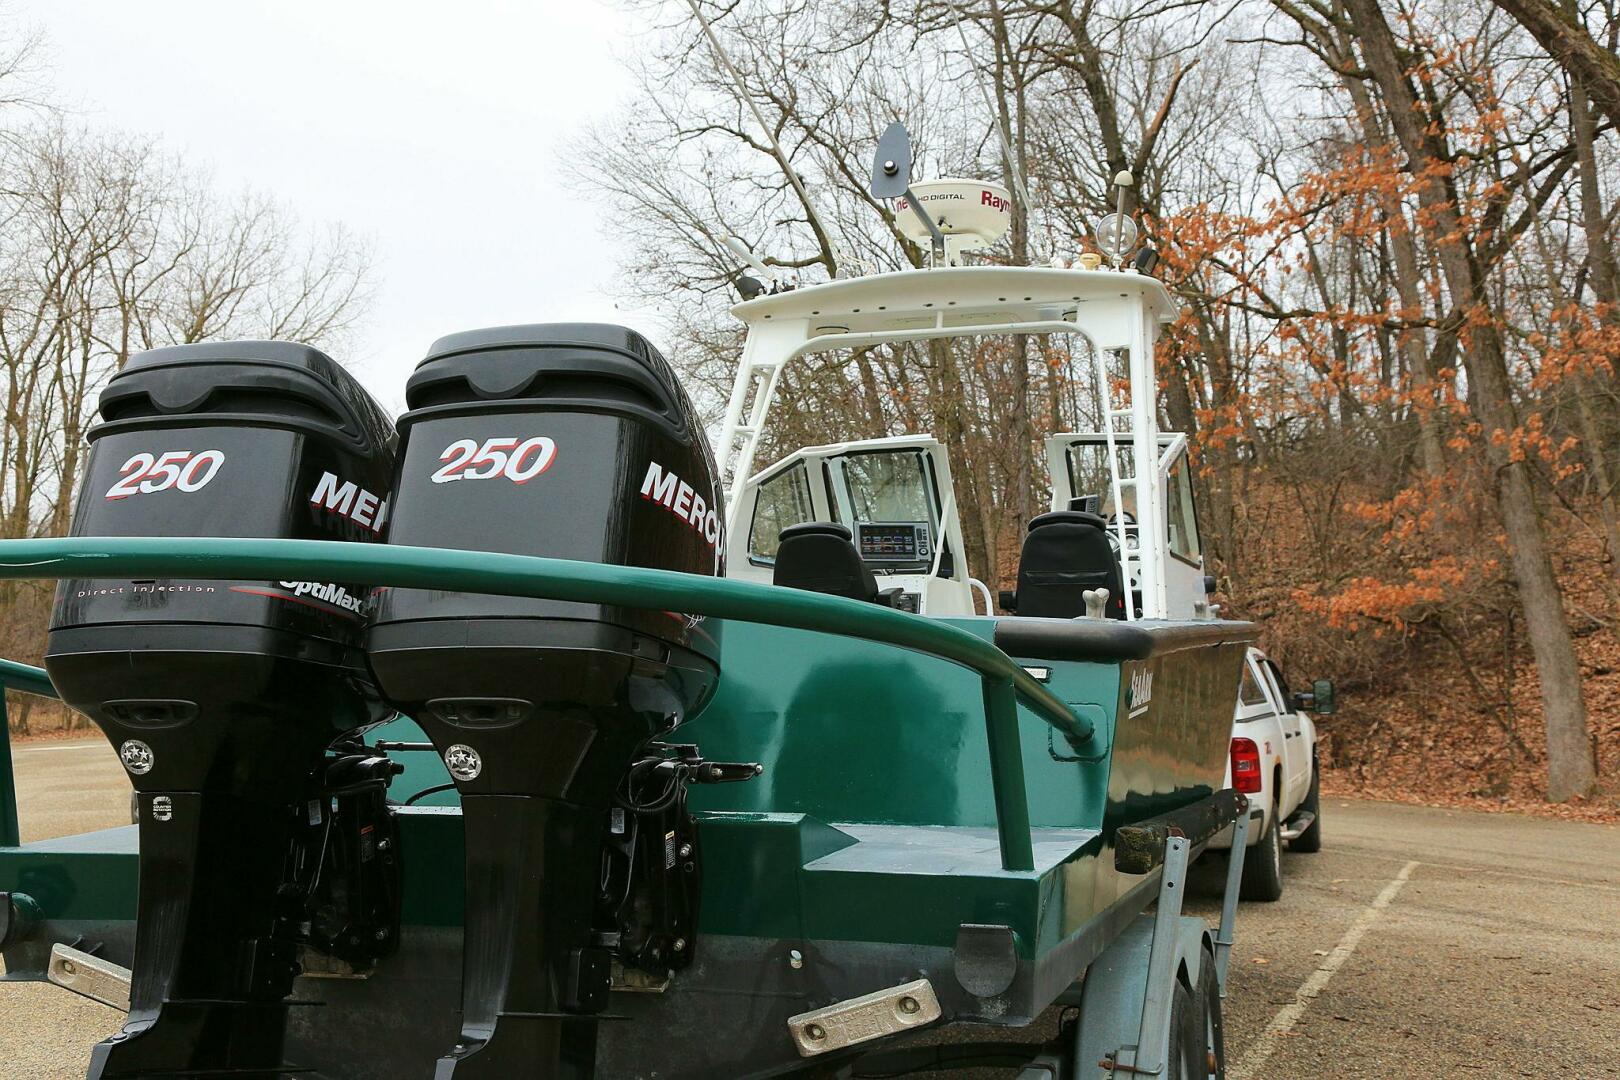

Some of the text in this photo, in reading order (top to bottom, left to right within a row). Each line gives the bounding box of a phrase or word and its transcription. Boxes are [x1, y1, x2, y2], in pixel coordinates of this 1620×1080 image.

[930, 193, 965, 201] DIGITAL
[105, 449, 225, 500] 250
[430, 436, 557, 485] 250
[77, 587, 124, 599] Direct
